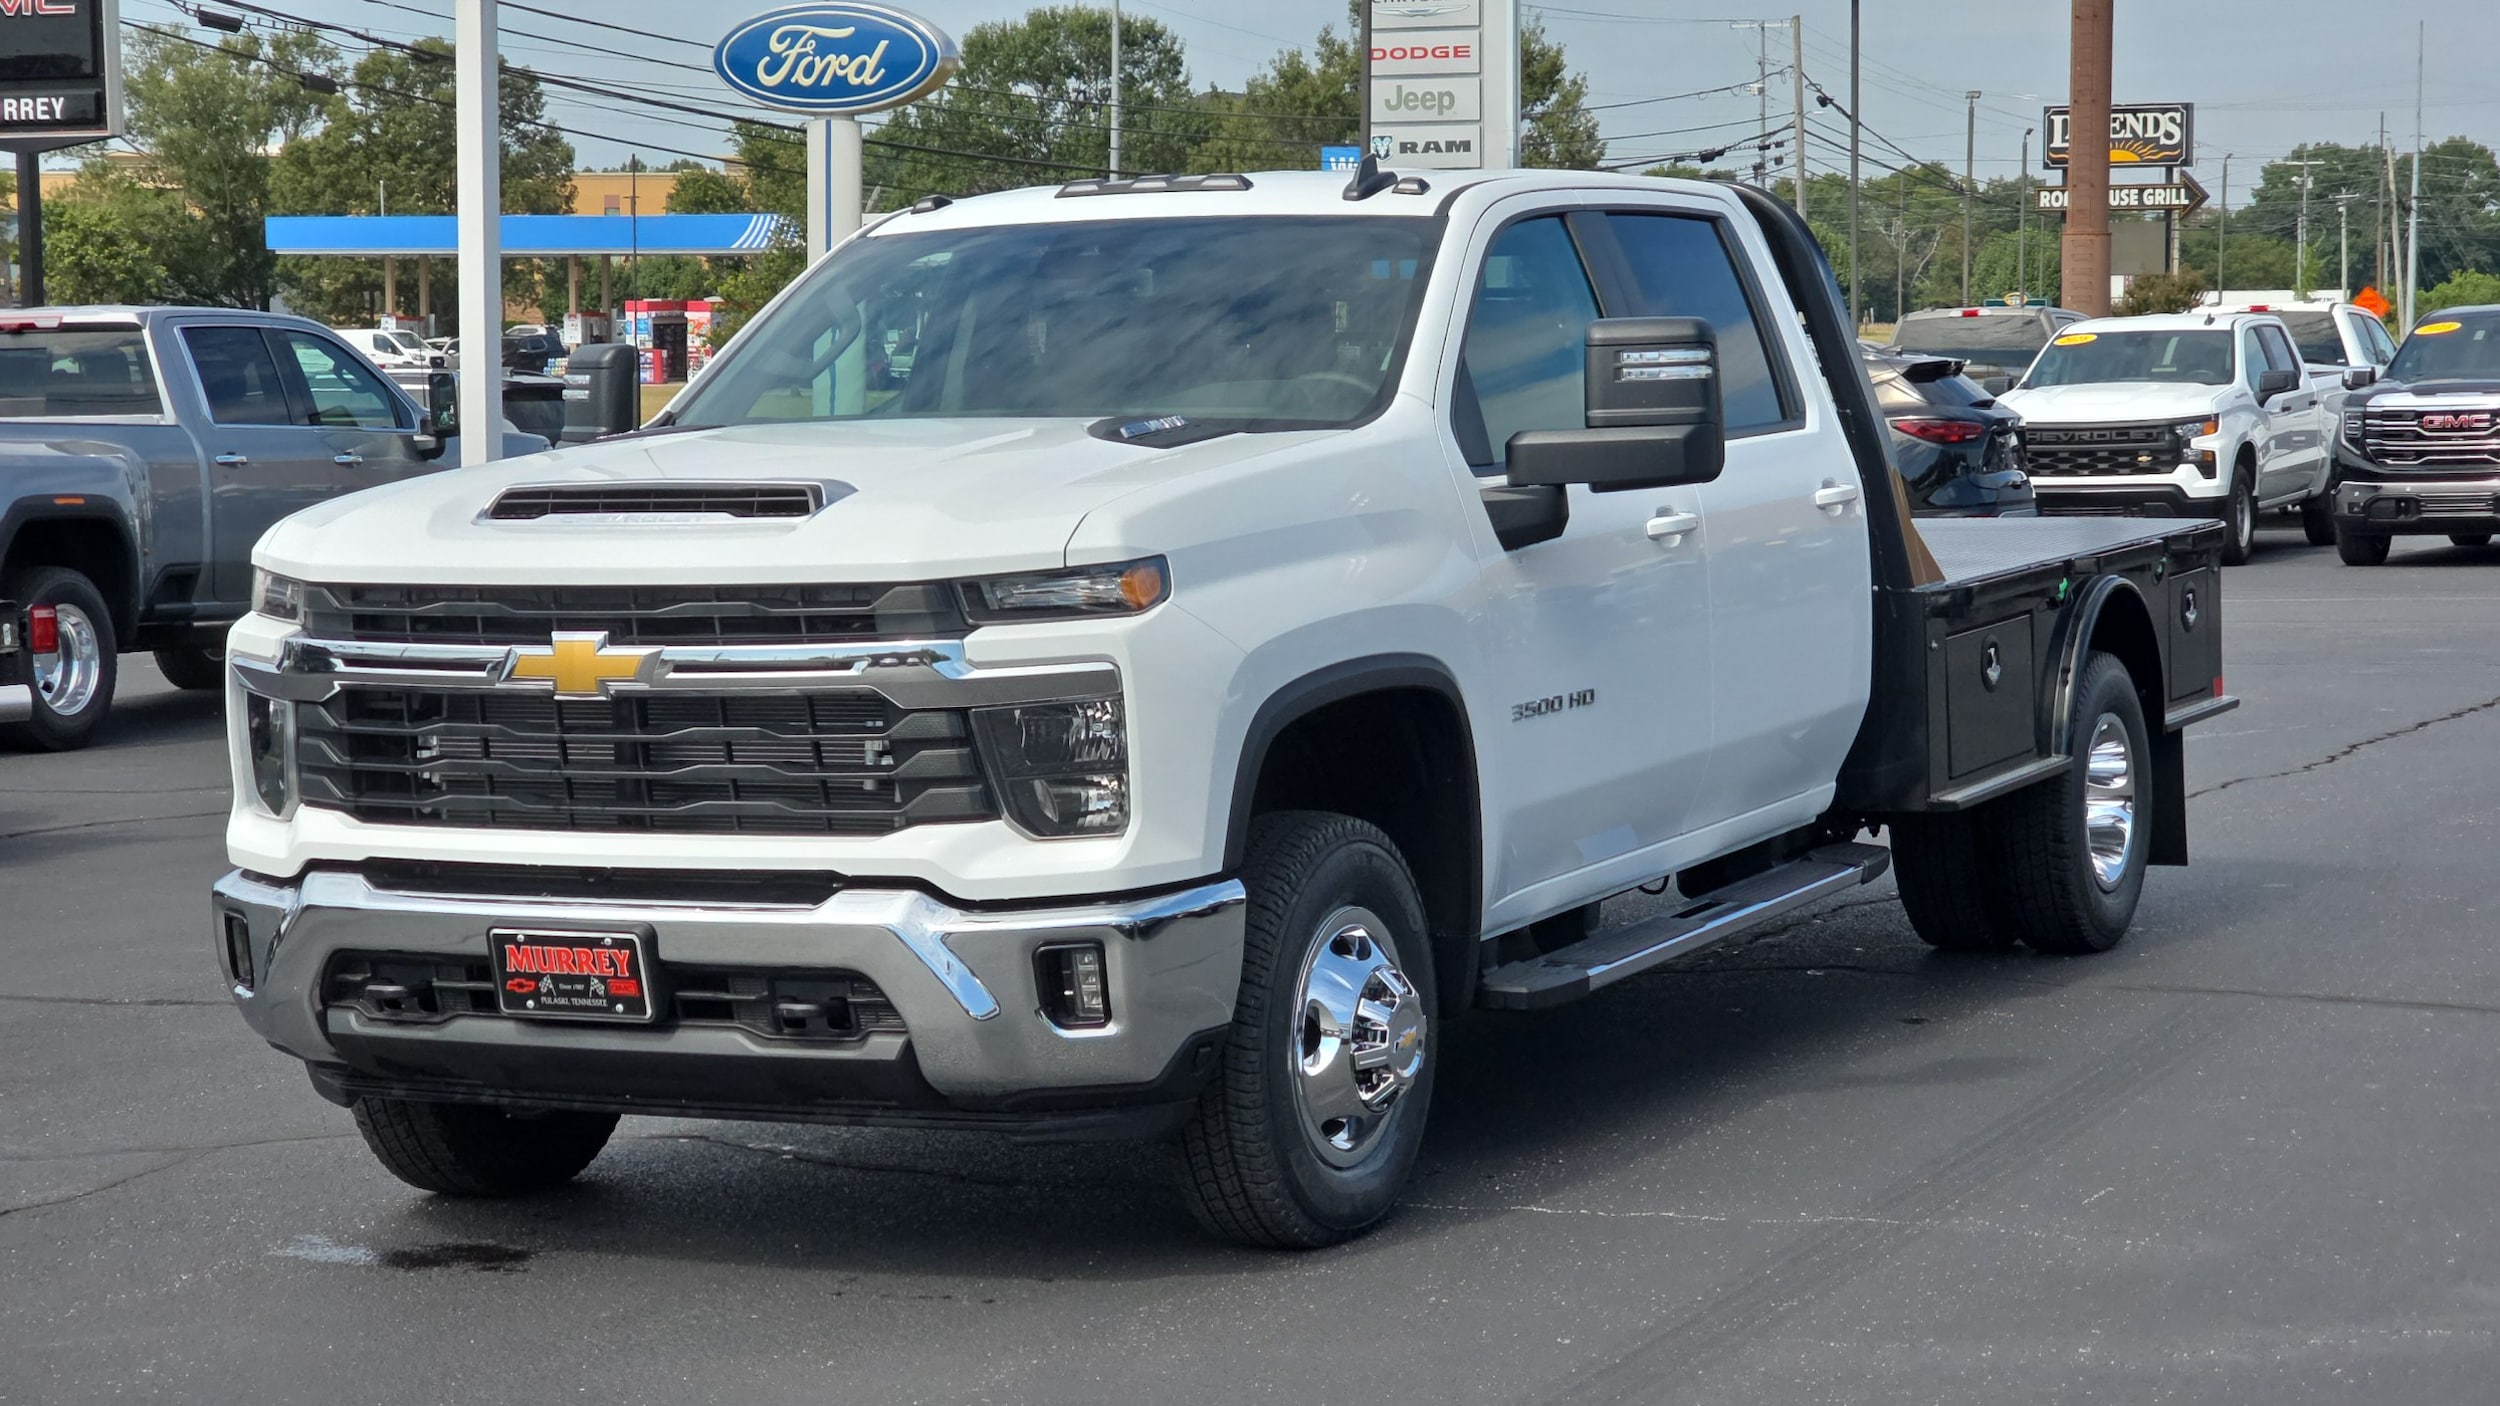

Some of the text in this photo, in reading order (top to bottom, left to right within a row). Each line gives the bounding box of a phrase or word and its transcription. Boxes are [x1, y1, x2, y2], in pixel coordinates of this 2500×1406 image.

[757, 24, 889, 87] Ford
[1370, 45, 1471, 61] DODGE
[1384, 84, 1456, 116] Jeep
[2050, 112, 2182, 148] LENDS
[1399, 140, 1471, 154] RAM
[2039, 187, 2189, 208] ROUSE GRILL
[2423, 414, 2491, 428] GMC
[2026, 428, 2163, 442] HEVROLET
[1511, 688, 1595, 723] 3500 HD
[504, 945, 630, 977] MURREY
